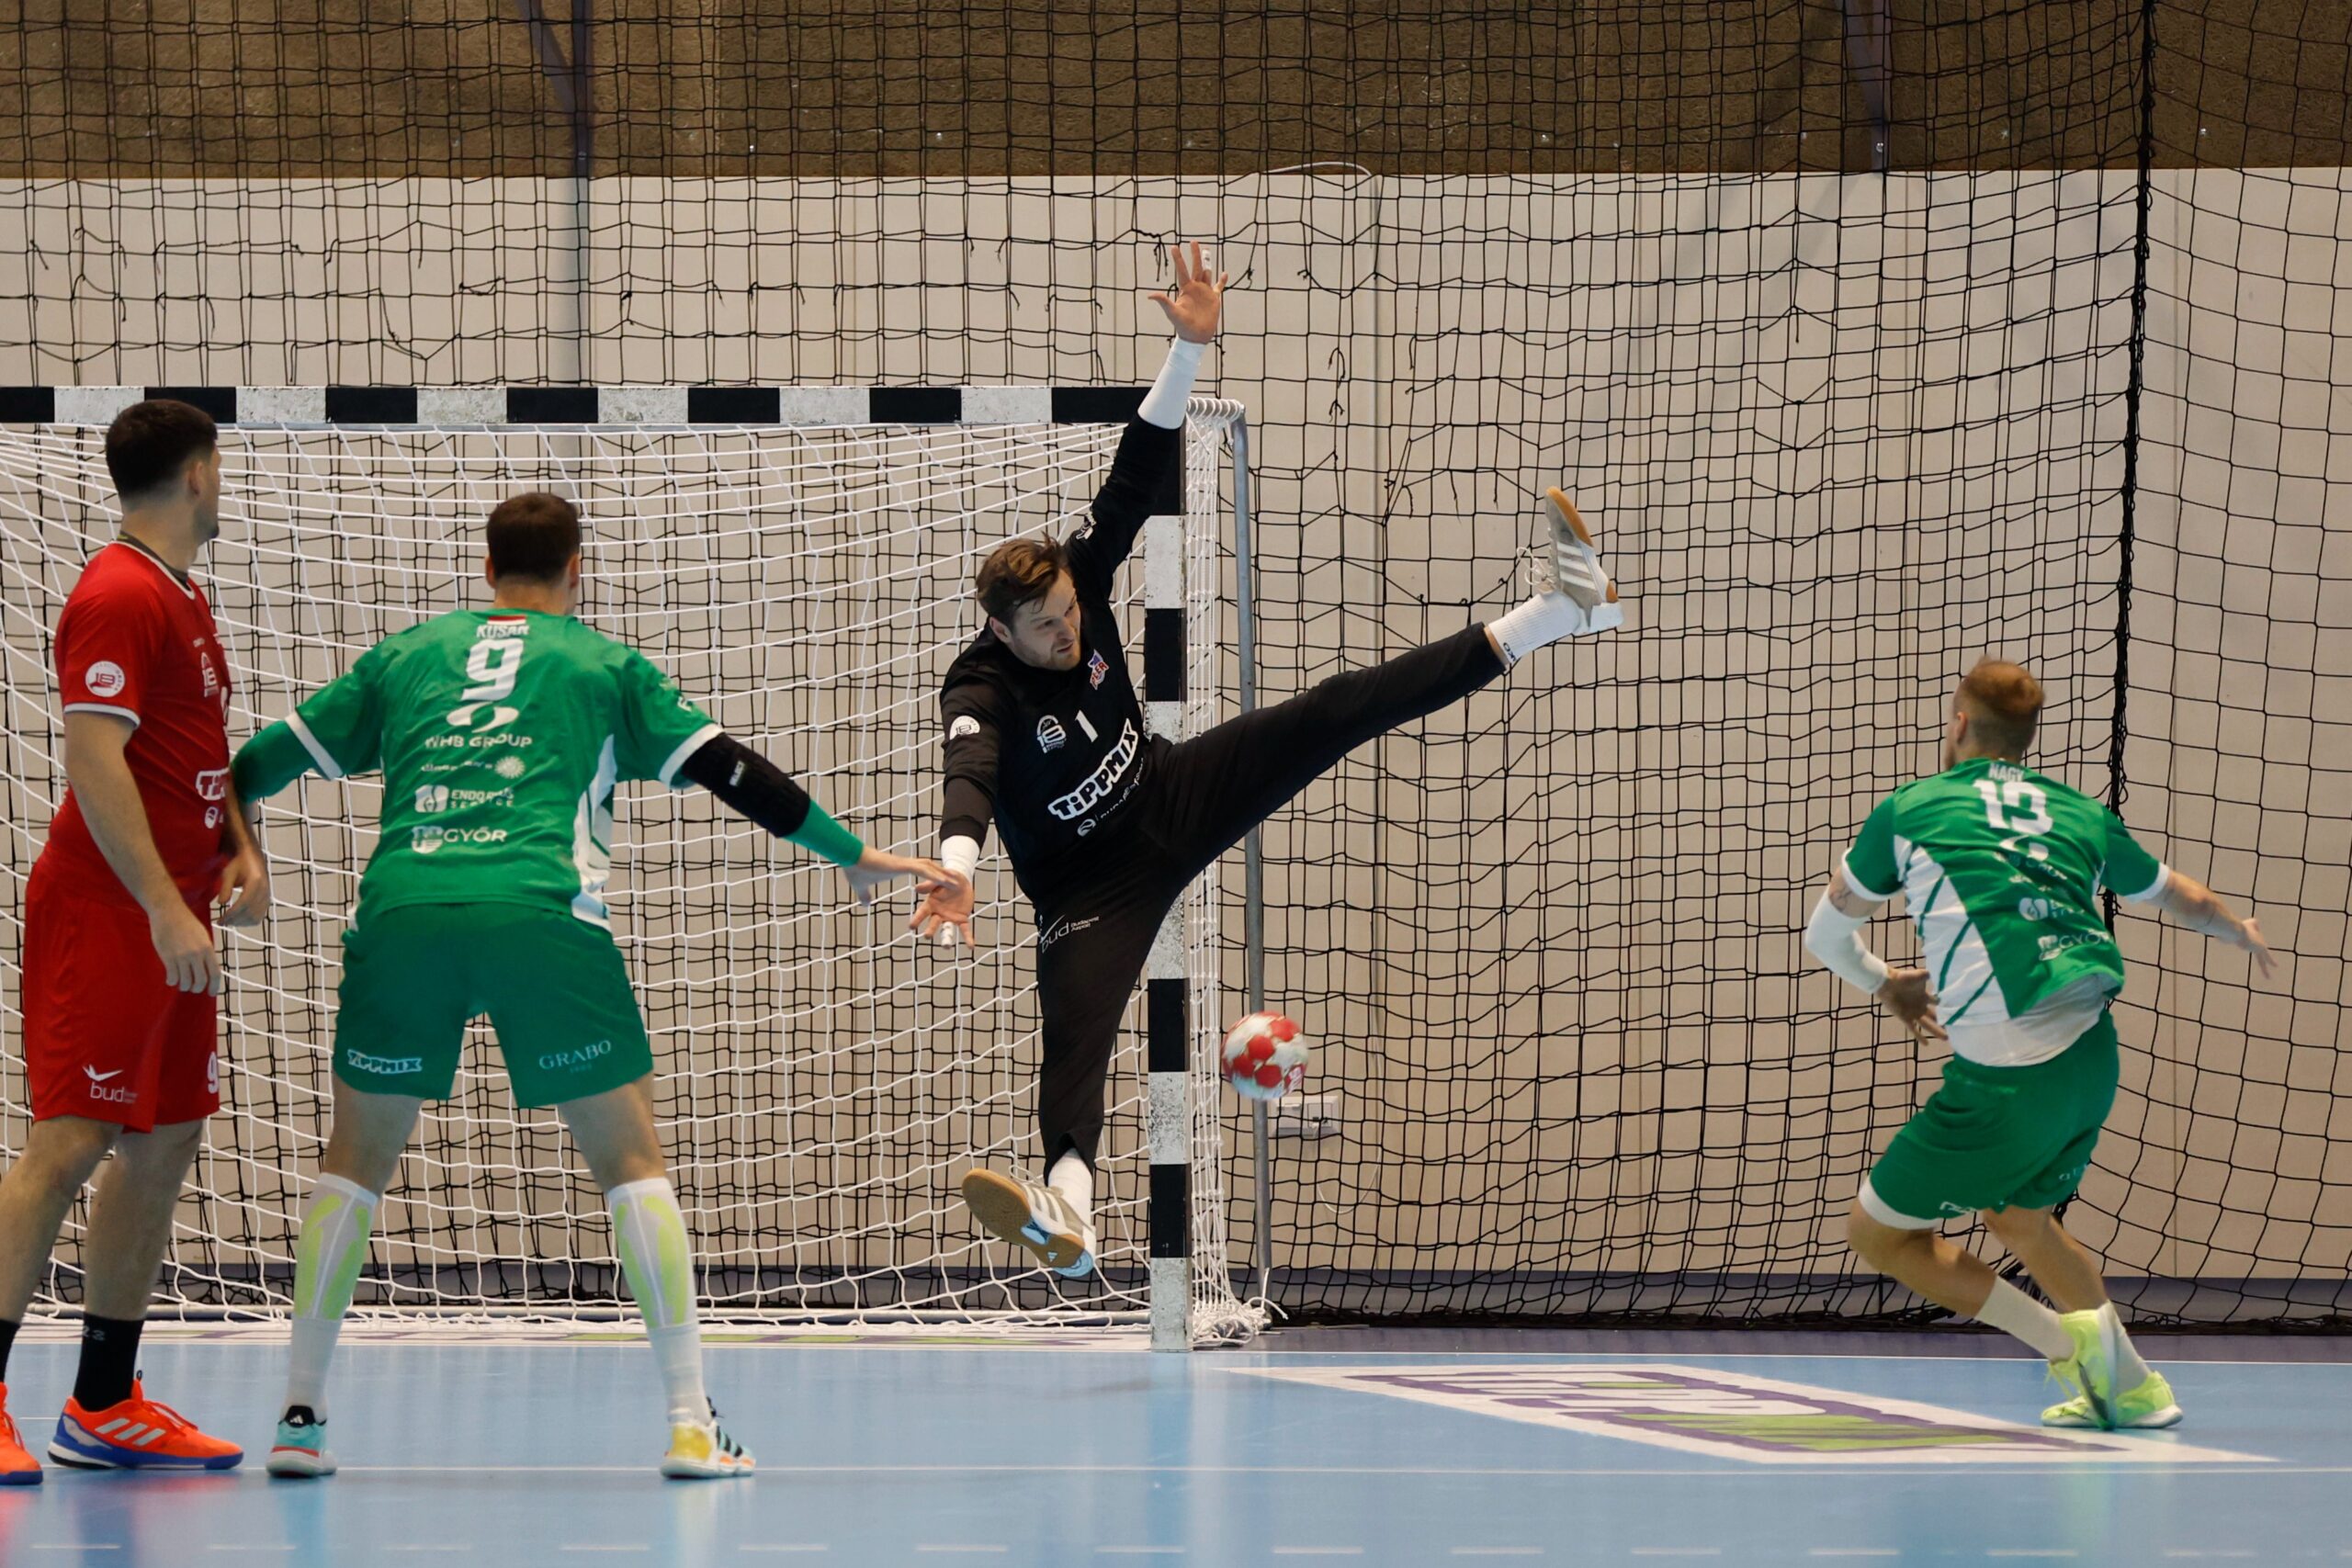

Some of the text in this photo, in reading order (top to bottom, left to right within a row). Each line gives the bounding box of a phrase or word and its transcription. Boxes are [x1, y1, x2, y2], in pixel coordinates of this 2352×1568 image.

[460, 638, 524, 701] 9
[469, 733, 533, 749] GROUP
[1074, 709, 1099, 743] 1
[538, 1040, 612, 1070] GRABO
